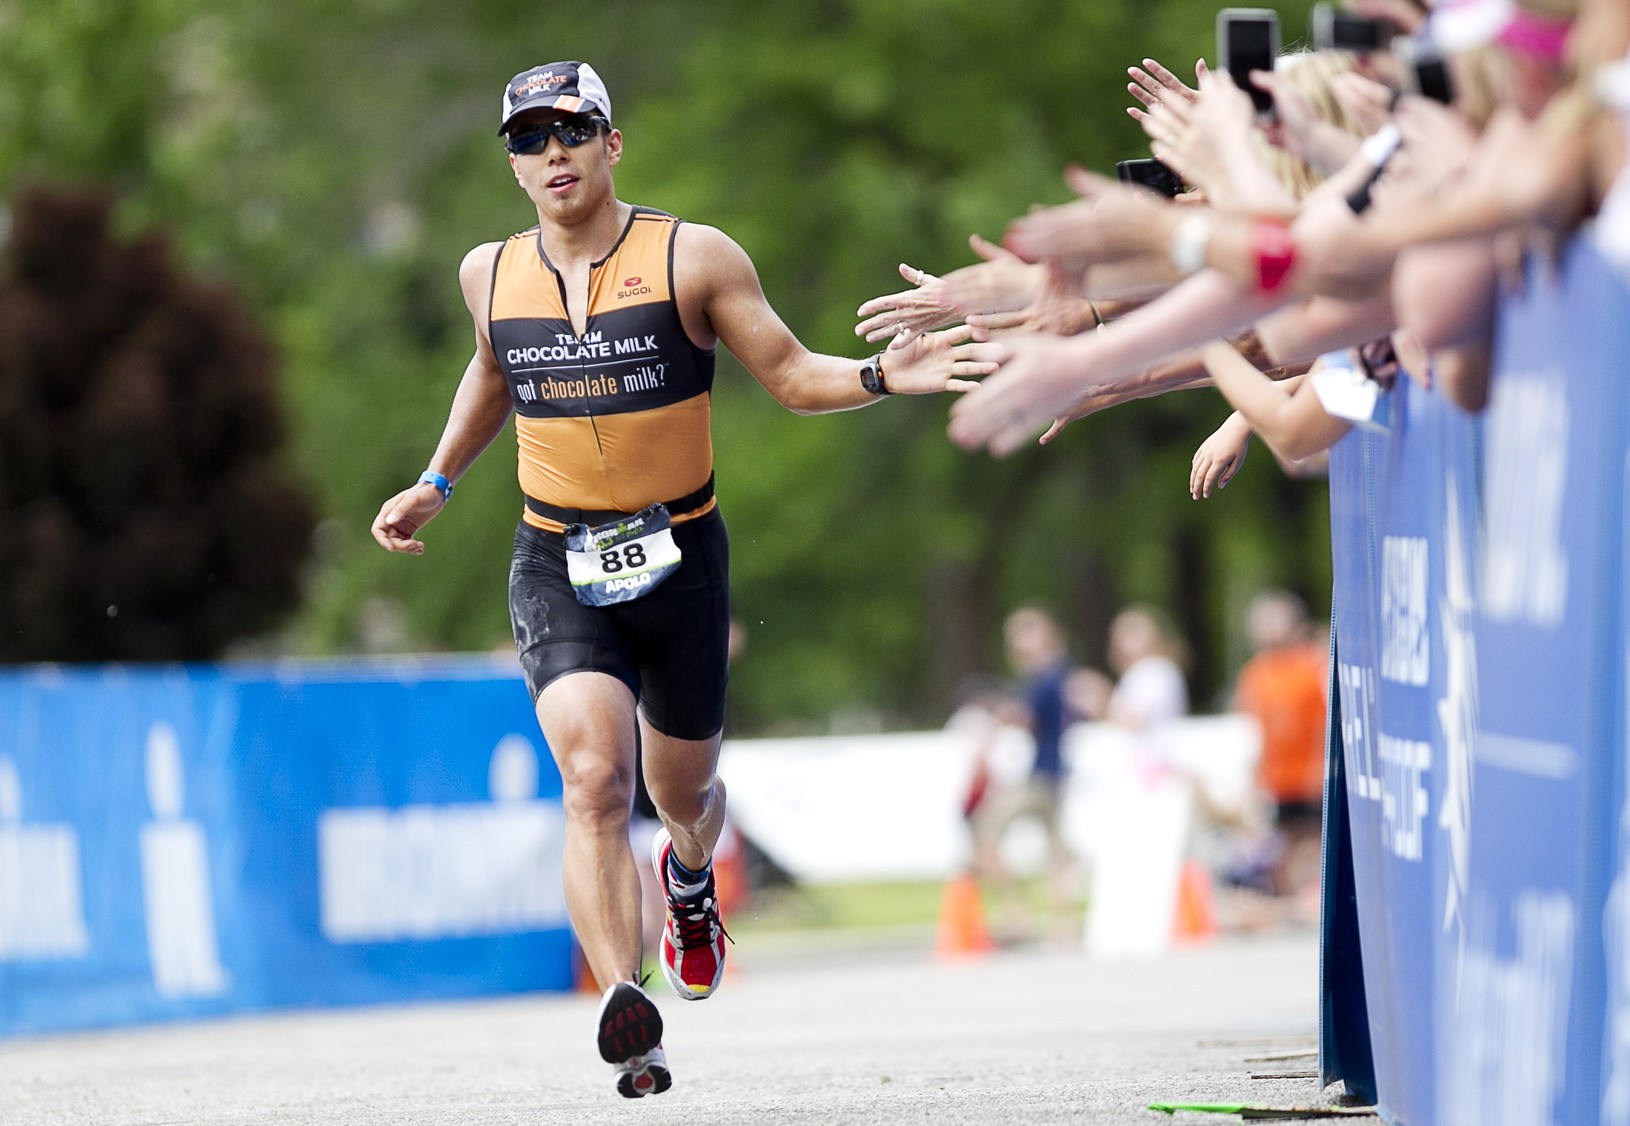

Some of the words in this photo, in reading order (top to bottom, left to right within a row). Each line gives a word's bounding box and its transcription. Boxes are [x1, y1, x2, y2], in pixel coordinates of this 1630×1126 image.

[515, 75, 567, 97] CHOCOLATE
[526, 71, 553, 83] TEAM
[528, 83, 551, 96] MILK
[506, 343, 611, 365] CHOCOLATE
[615, 335, 658, 355] MILK
[517, 379, 536, 404] got
[541, 374, 618, 400] chocolate
[623, 363, 665, 393] milk?
[600, 542, 647, 573] 88
[605, 572, 651, 594] APOLO
